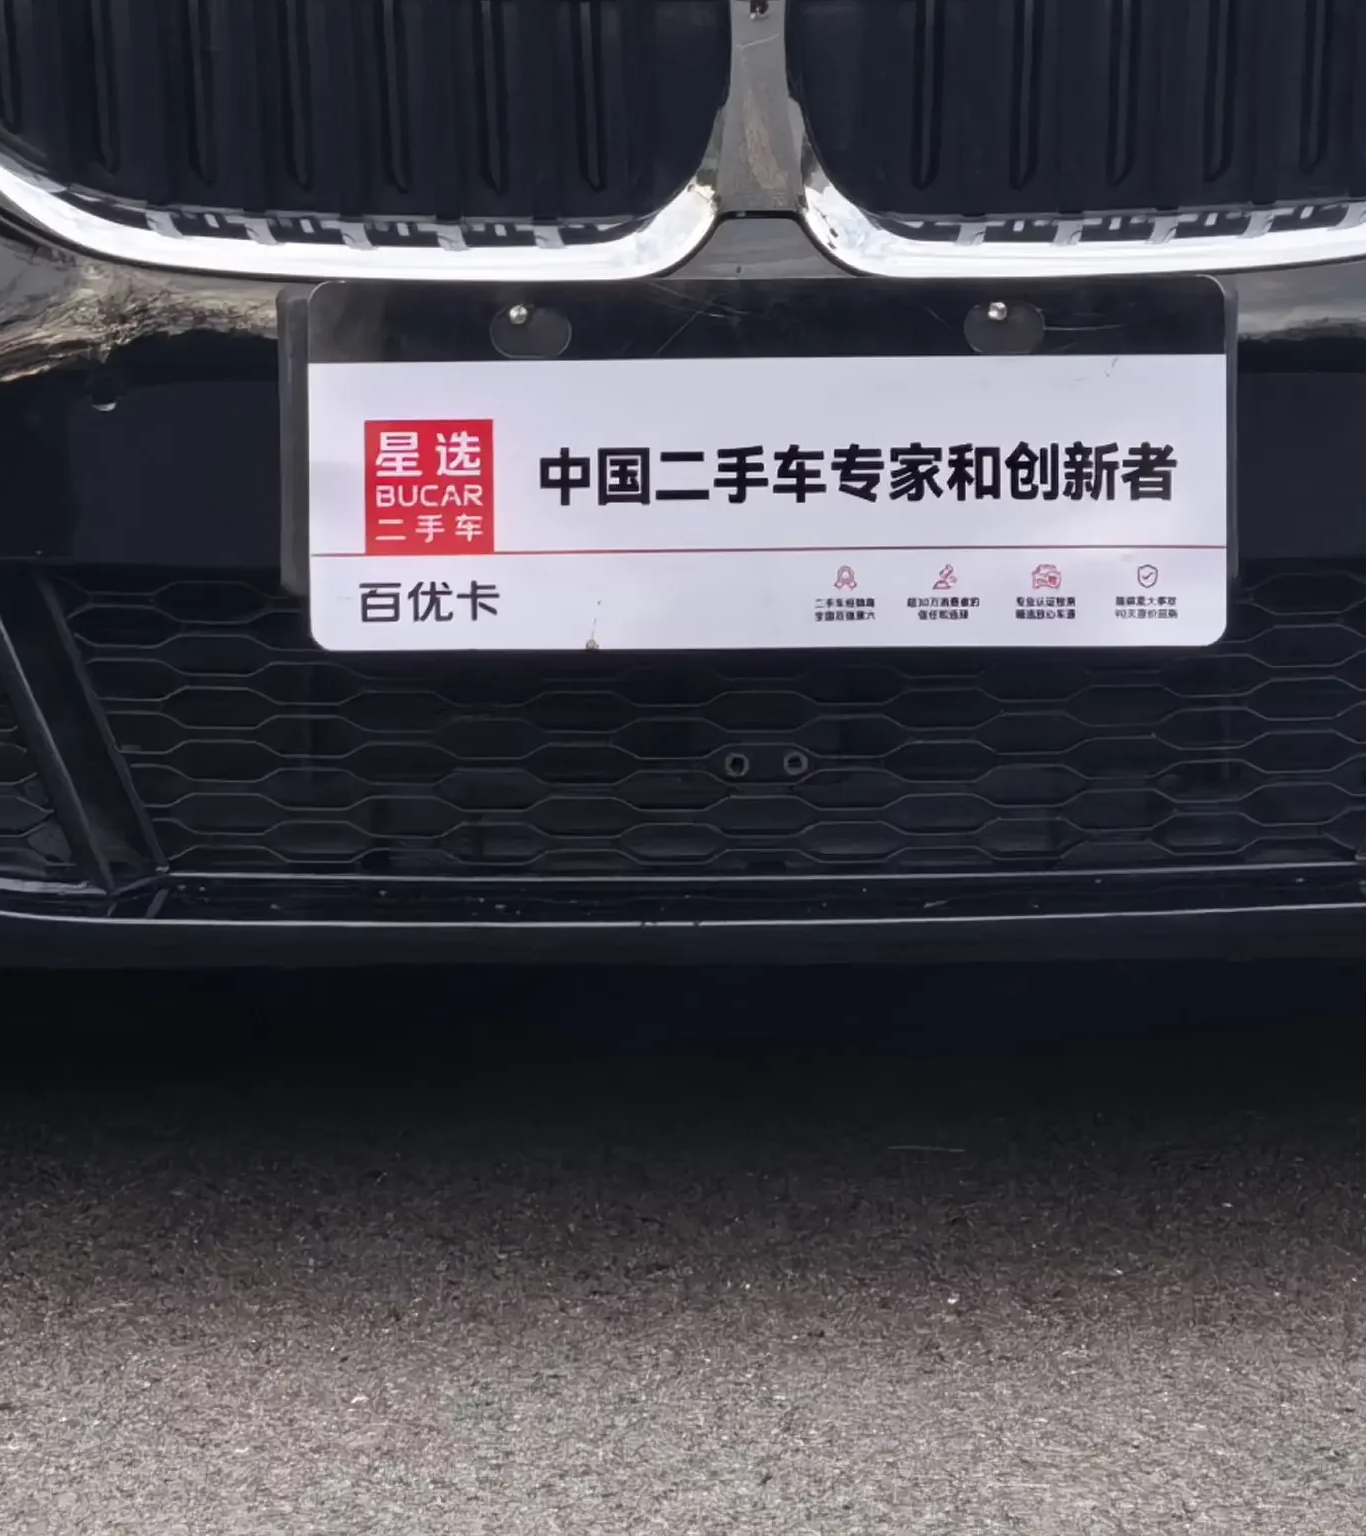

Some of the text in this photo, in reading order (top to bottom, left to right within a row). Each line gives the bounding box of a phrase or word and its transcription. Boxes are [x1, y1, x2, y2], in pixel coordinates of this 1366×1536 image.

[375, 430, 481, 477] 星选
[539, 440, 1178, 506] 中国二手车专家和创新者
[375, 484, 483, 508] BUCAR
[375, 514, 483, 543] 二手车
[359, 580, 500, 622] 百优卡
